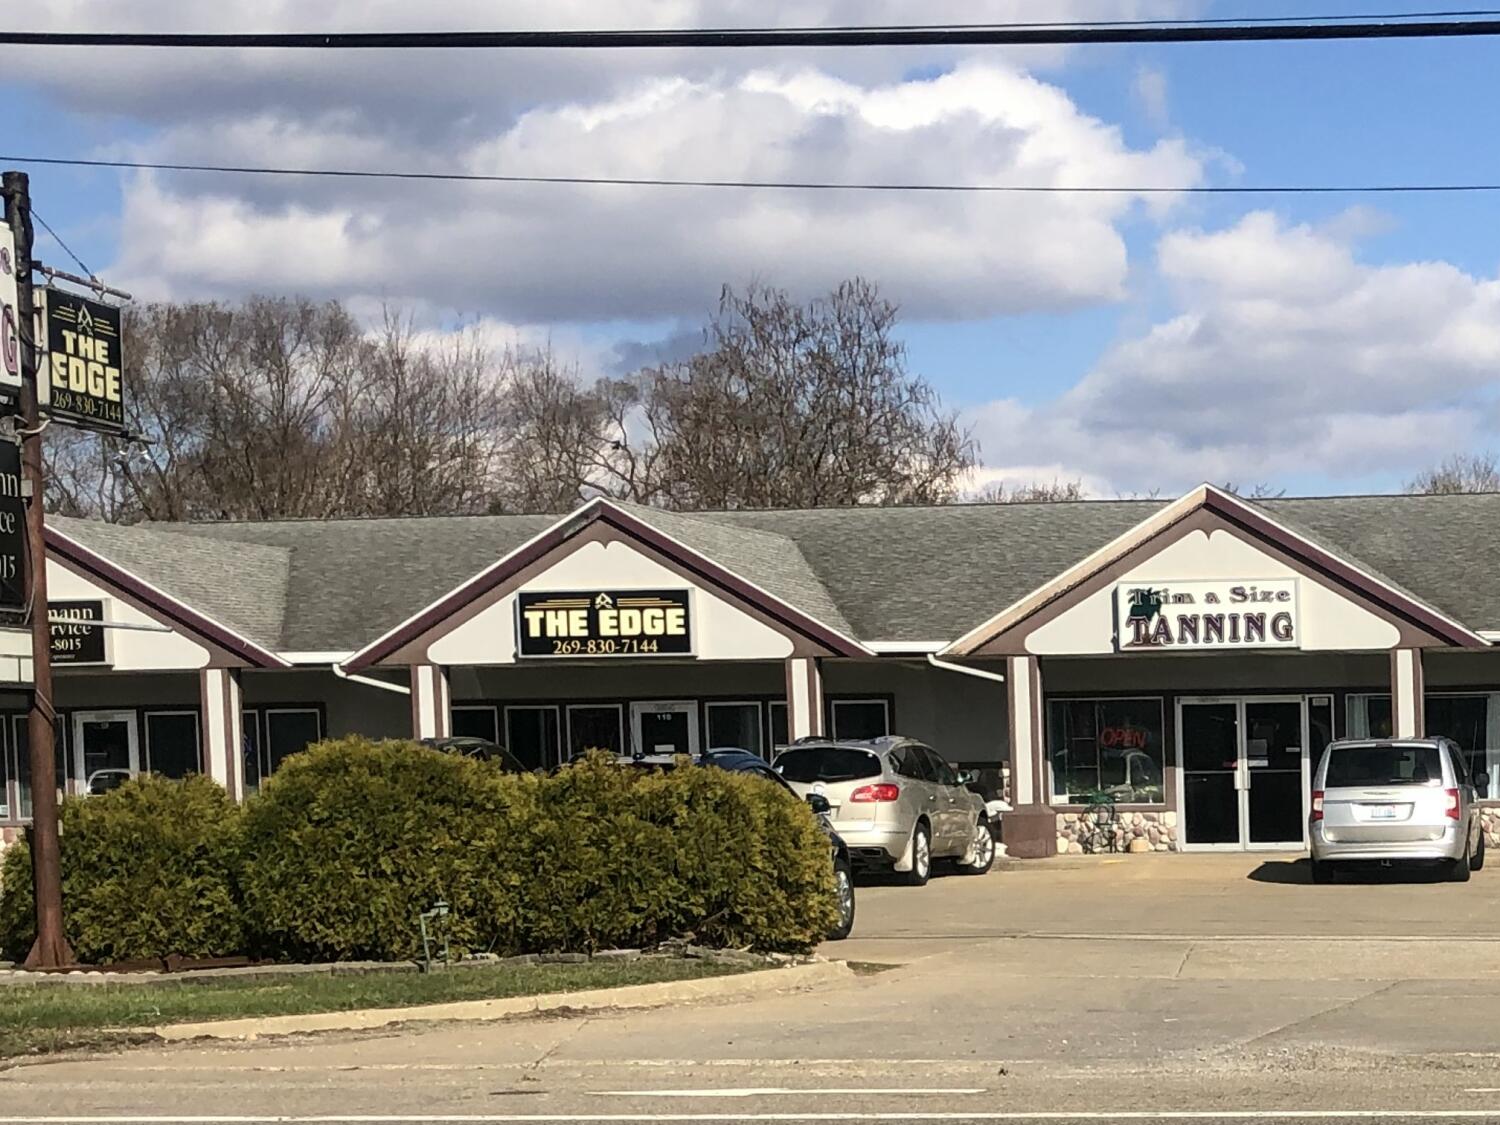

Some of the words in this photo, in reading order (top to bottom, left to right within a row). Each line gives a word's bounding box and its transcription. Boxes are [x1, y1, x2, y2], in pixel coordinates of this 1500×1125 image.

[62, 329, 109, 364] THE
[51, 351, 120, 402] EDGE
[53, 389, 121, 422] 269-830-7144
[1127, 588, 1196, 606] Trim
[1230, 586, 1291, 604] Size
[524, 609, 589, 637] THE
[598, 608, 686, 636] EDGE
[1125, 611, 1293, 645] TANNING
[552, 639, 658, 654] 269-830-7144
